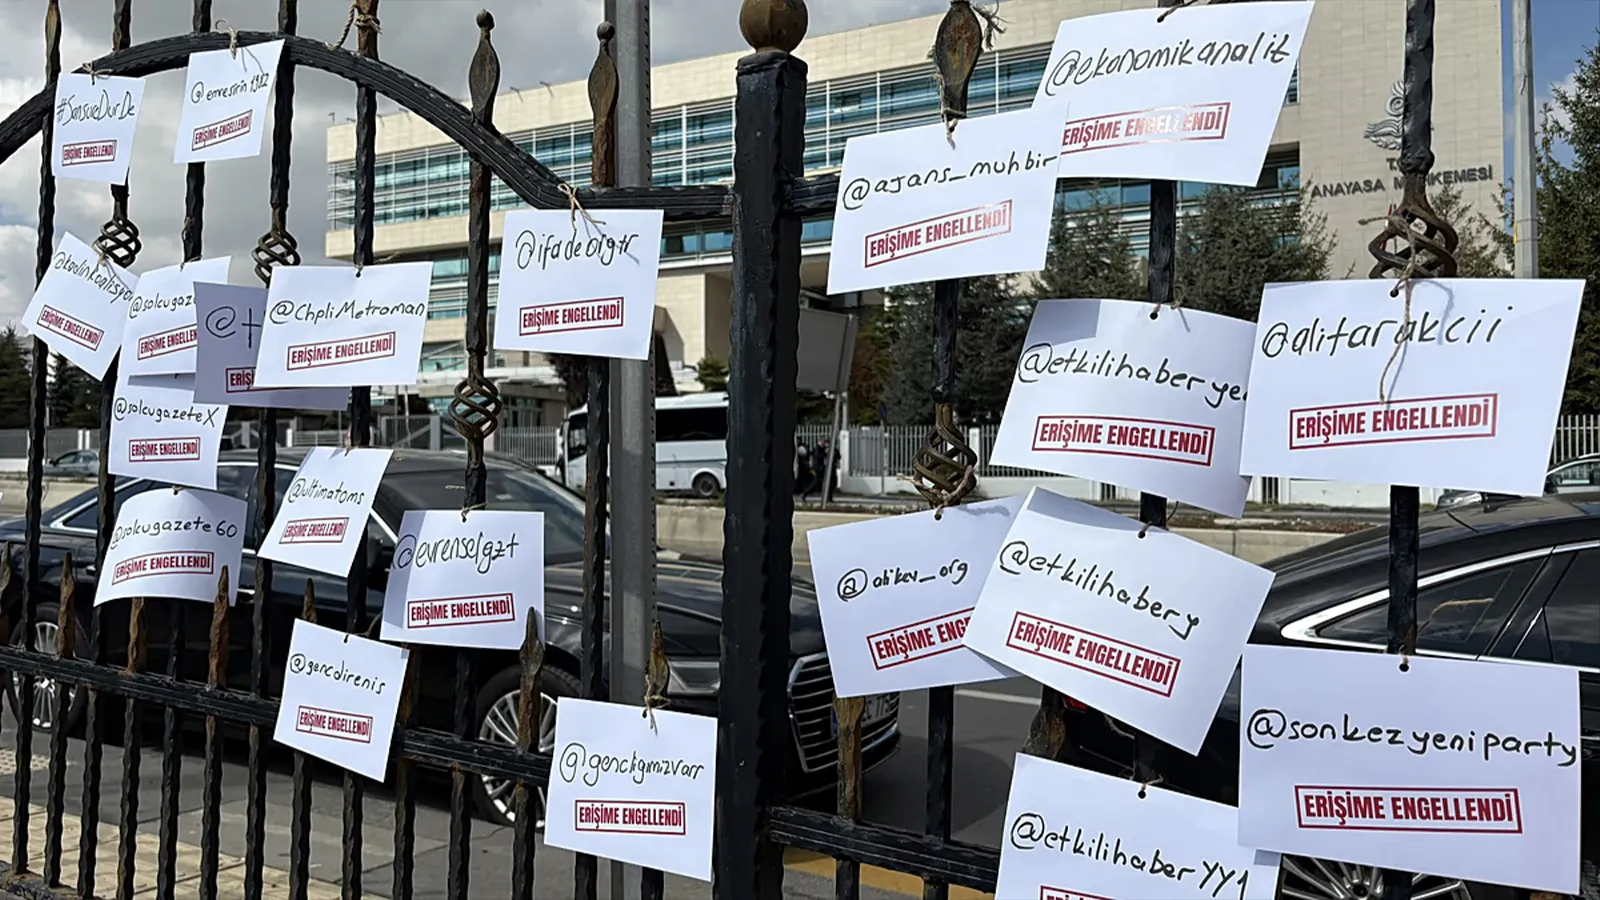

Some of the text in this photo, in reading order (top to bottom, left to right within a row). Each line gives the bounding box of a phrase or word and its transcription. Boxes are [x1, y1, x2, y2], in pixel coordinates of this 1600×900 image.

[1062, 120, 1122, 149] ERİŞİME
[843, 150, 1058, 210] @ajans_muhbir
[1311, 165, 1493, 198] ANAYASA MKEMESİ
[870, 205, 1007, 258] ERİŞİME ENGELLENDİ
[129, 293, 197, 319] @solcugaz
[269, 300, 425, 325] @ChpliMetroman
[523, 300, 620, 331] ERİŞİME ENGELLENDİ
[291, 334, 392, 367] ERİŞİME ENGELLENDİ
[1018, 342, 1248, 409] @etkilihaberye
[1039, 419, 1208, 455] ERİŞİME ENGELLENDİ
[1296, 399, 1489, 443] ERİŞİME ENGELLENDİ
[115, 554, 210, 578] ERİŞİME ENGELLENDİ
[999, 540, 1200, 641] @etkilihabery
[411, 596, 511, 624] ERİŞİME ENGELLENDİ
[875, 627, 936, 660] ERİŞİME
[1014, 620, 1174, 686] ERİŞİME ENGELLENDİ
[299, 711, 370, 736] ERİŞİME ENGELLENDİ
[579, 804, 682, 828] ERİŞİME ENGELLENDİ
[1304, 790, 1514, 824] ERİŞİME ENGELLENDİ
